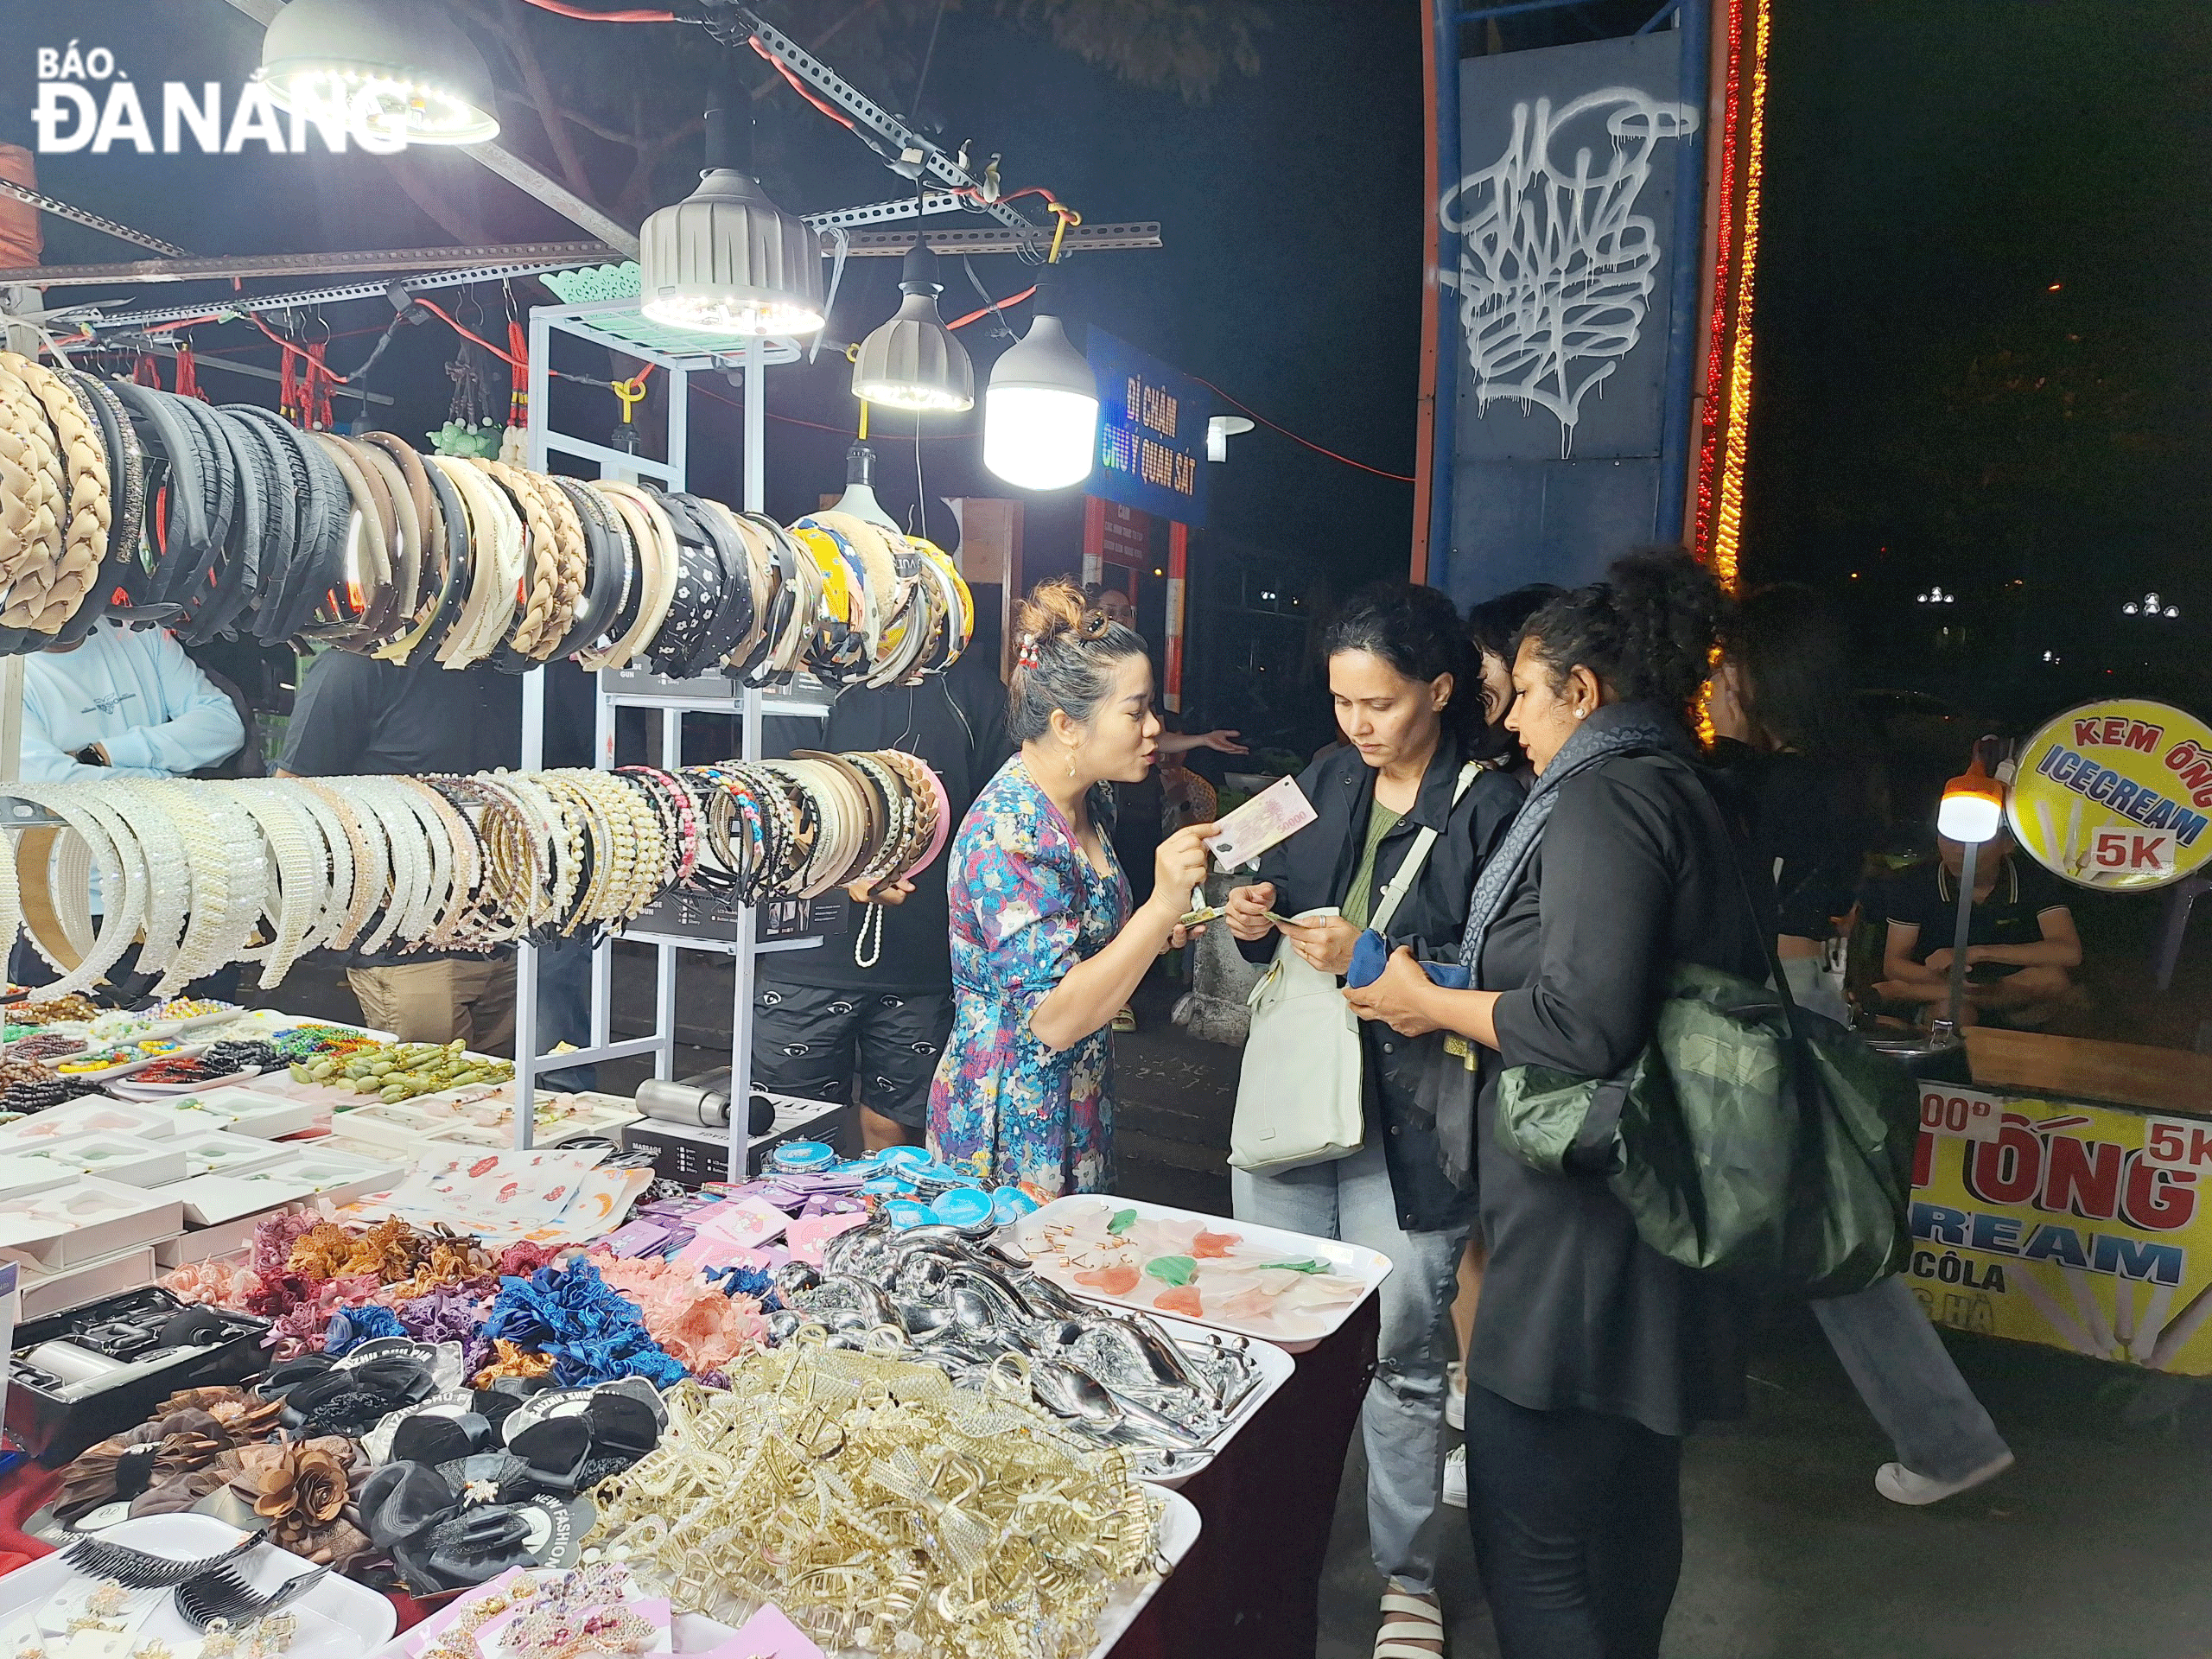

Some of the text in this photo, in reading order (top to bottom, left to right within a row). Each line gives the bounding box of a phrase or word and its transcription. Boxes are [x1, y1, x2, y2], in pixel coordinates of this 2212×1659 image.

[1142, 385, 1178, 441] CHẬM
[1141, 438, 1173, 488] QUAN
[1174, 447, 1196, 496] SÁT
[2074, 718, 2163, 755] KEM
[2039, 745, 2209, 846] ICECREAM
[2096, 835, 2166, 869] 5K
[2149, 1123, 2212, 1166] 5K
[1912, 1251, 2006, 1294] CÔLA
[531, 1493, 563, 1510] NEW
[544, 1508, 572, 1568] FASHION
